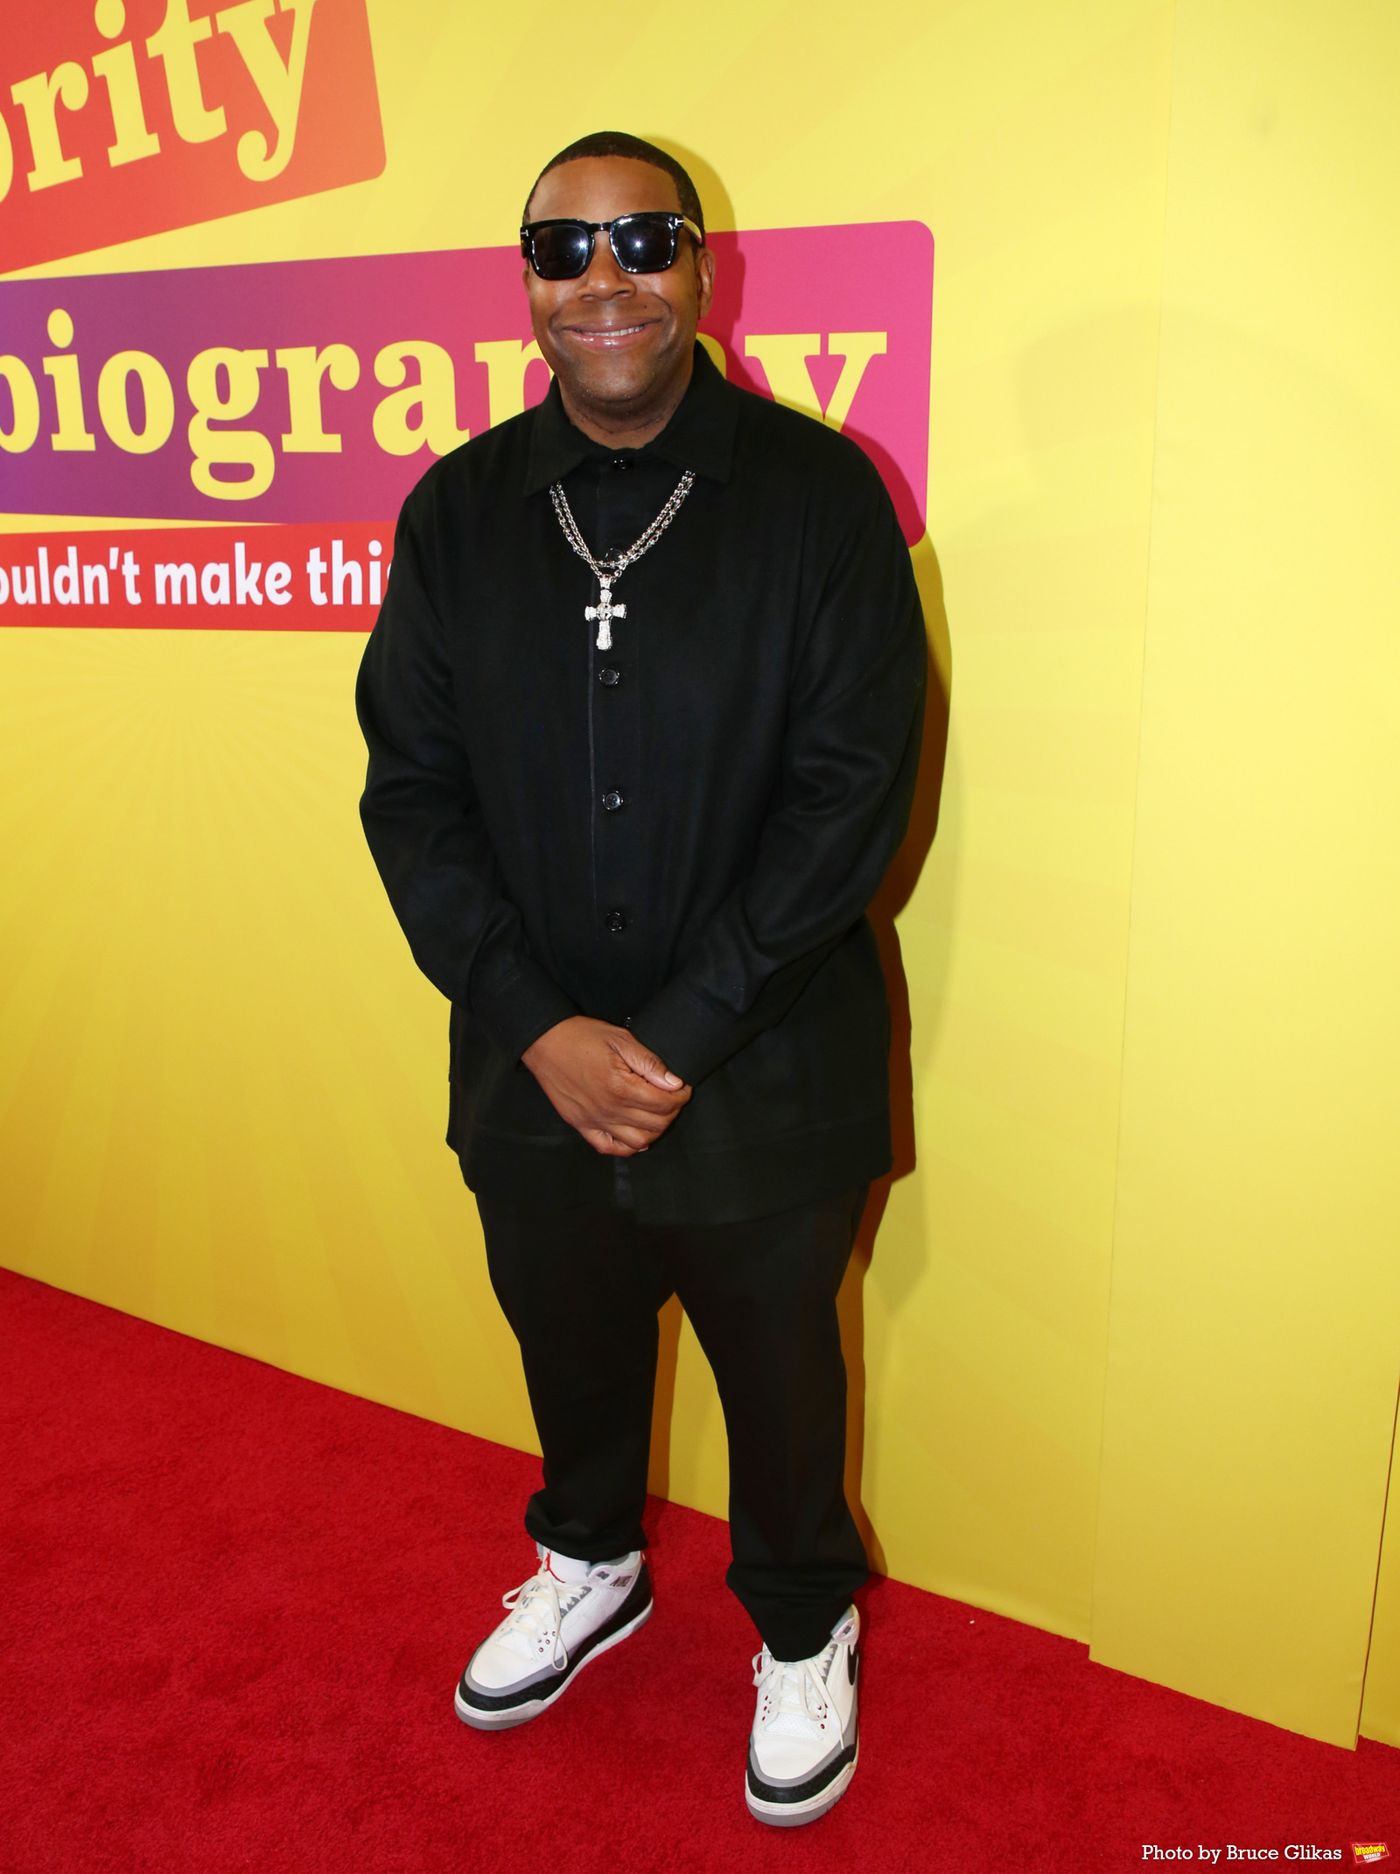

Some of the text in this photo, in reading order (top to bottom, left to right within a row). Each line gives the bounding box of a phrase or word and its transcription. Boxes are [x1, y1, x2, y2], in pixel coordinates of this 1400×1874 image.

[0, 0, 317, 201] rity
[154, 542, 293, 606] make
[306, 539, 394, 606] thi
